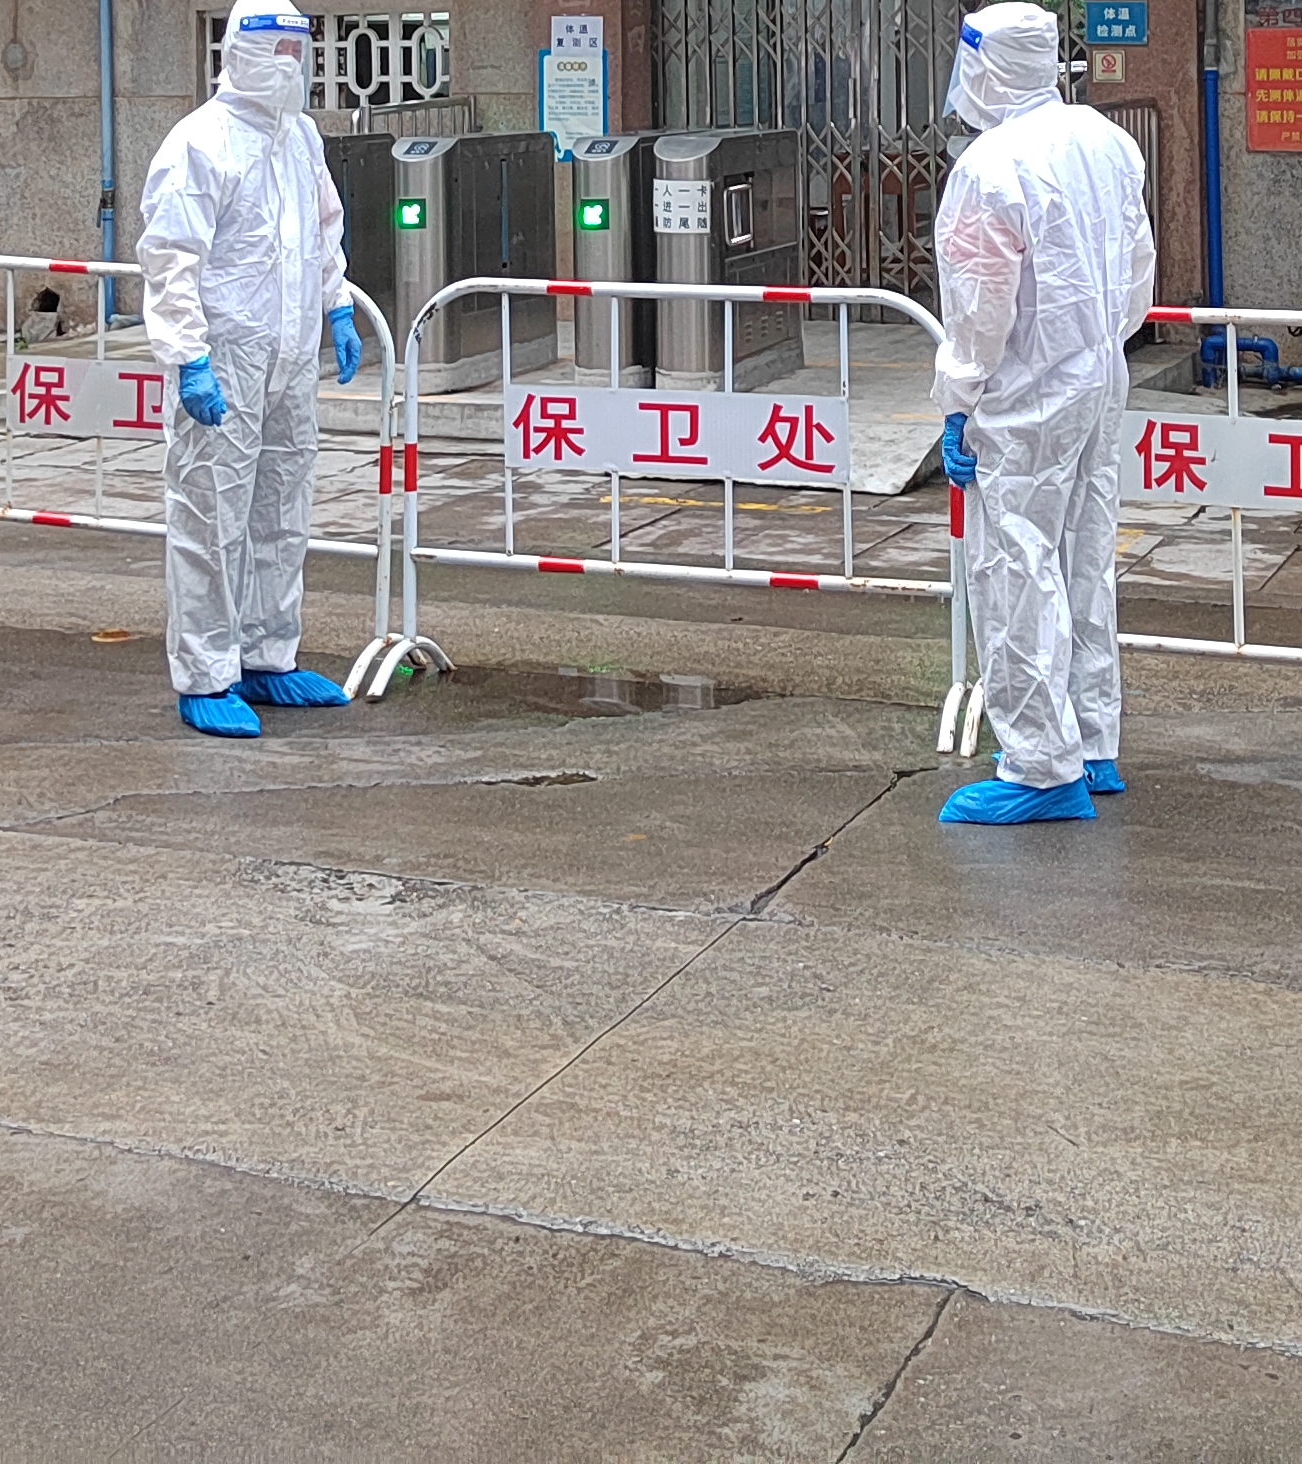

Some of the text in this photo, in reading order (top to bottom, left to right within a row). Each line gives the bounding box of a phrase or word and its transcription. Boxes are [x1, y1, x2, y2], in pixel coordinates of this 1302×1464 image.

[1104, 7, 1130, 20] 体温
[565, 24, 588, 34] 体温
[1096, 24, 1137, 37] 检测点
[556, 37, 598, 47] 复测区
[11, 362, 164, 430] 保卫
[512, 392, 837, 474] 保卫处
